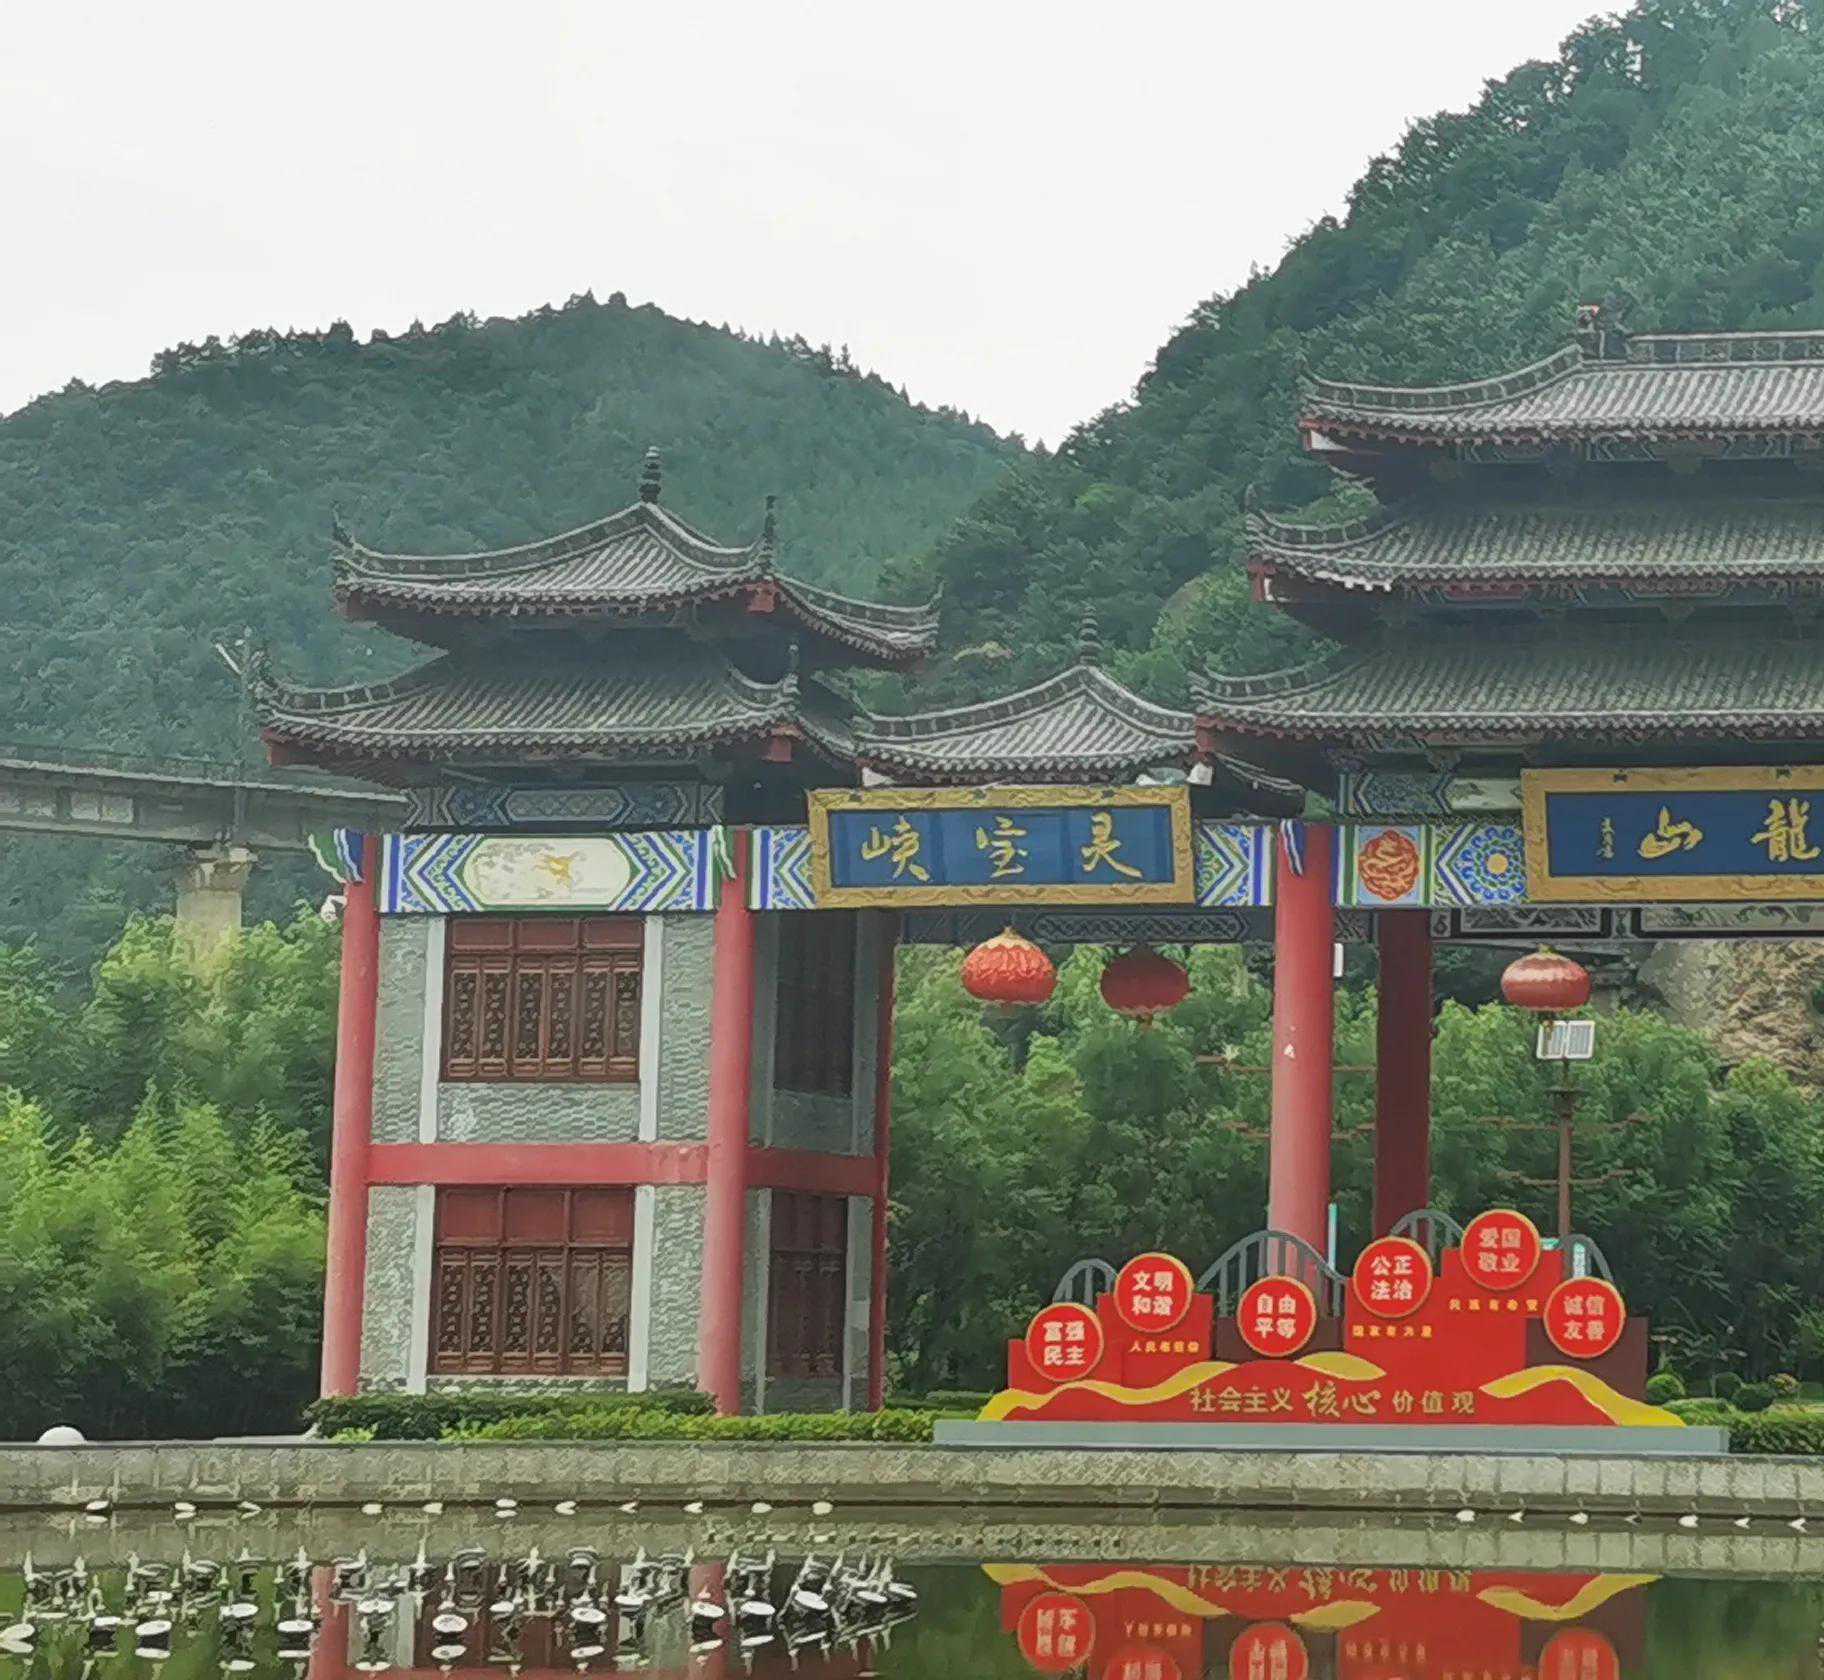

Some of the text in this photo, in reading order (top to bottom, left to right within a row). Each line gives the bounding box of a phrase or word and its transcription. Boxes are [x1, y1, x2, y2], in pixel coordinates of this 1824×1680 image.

[1370, 1255, 1413, 1276] 公正
[1132, 1271, 1174, 1291] 文明
[1370, 1279, 1413, 1301] 法治
[1132, 1295, 1173, 1316] 和谐
[1257, 1294, 1297, 1314] 自由
[1043, 1321, 1085, 1342] 富强
[1255, 1318, 1297, 1339] 平等
[1564, 1320, 1605, 1341] 友善
[1044, 1345, 1085, 1366] 民主
[1190, 1380, 1475, 1418] 社会主义核心价值观
